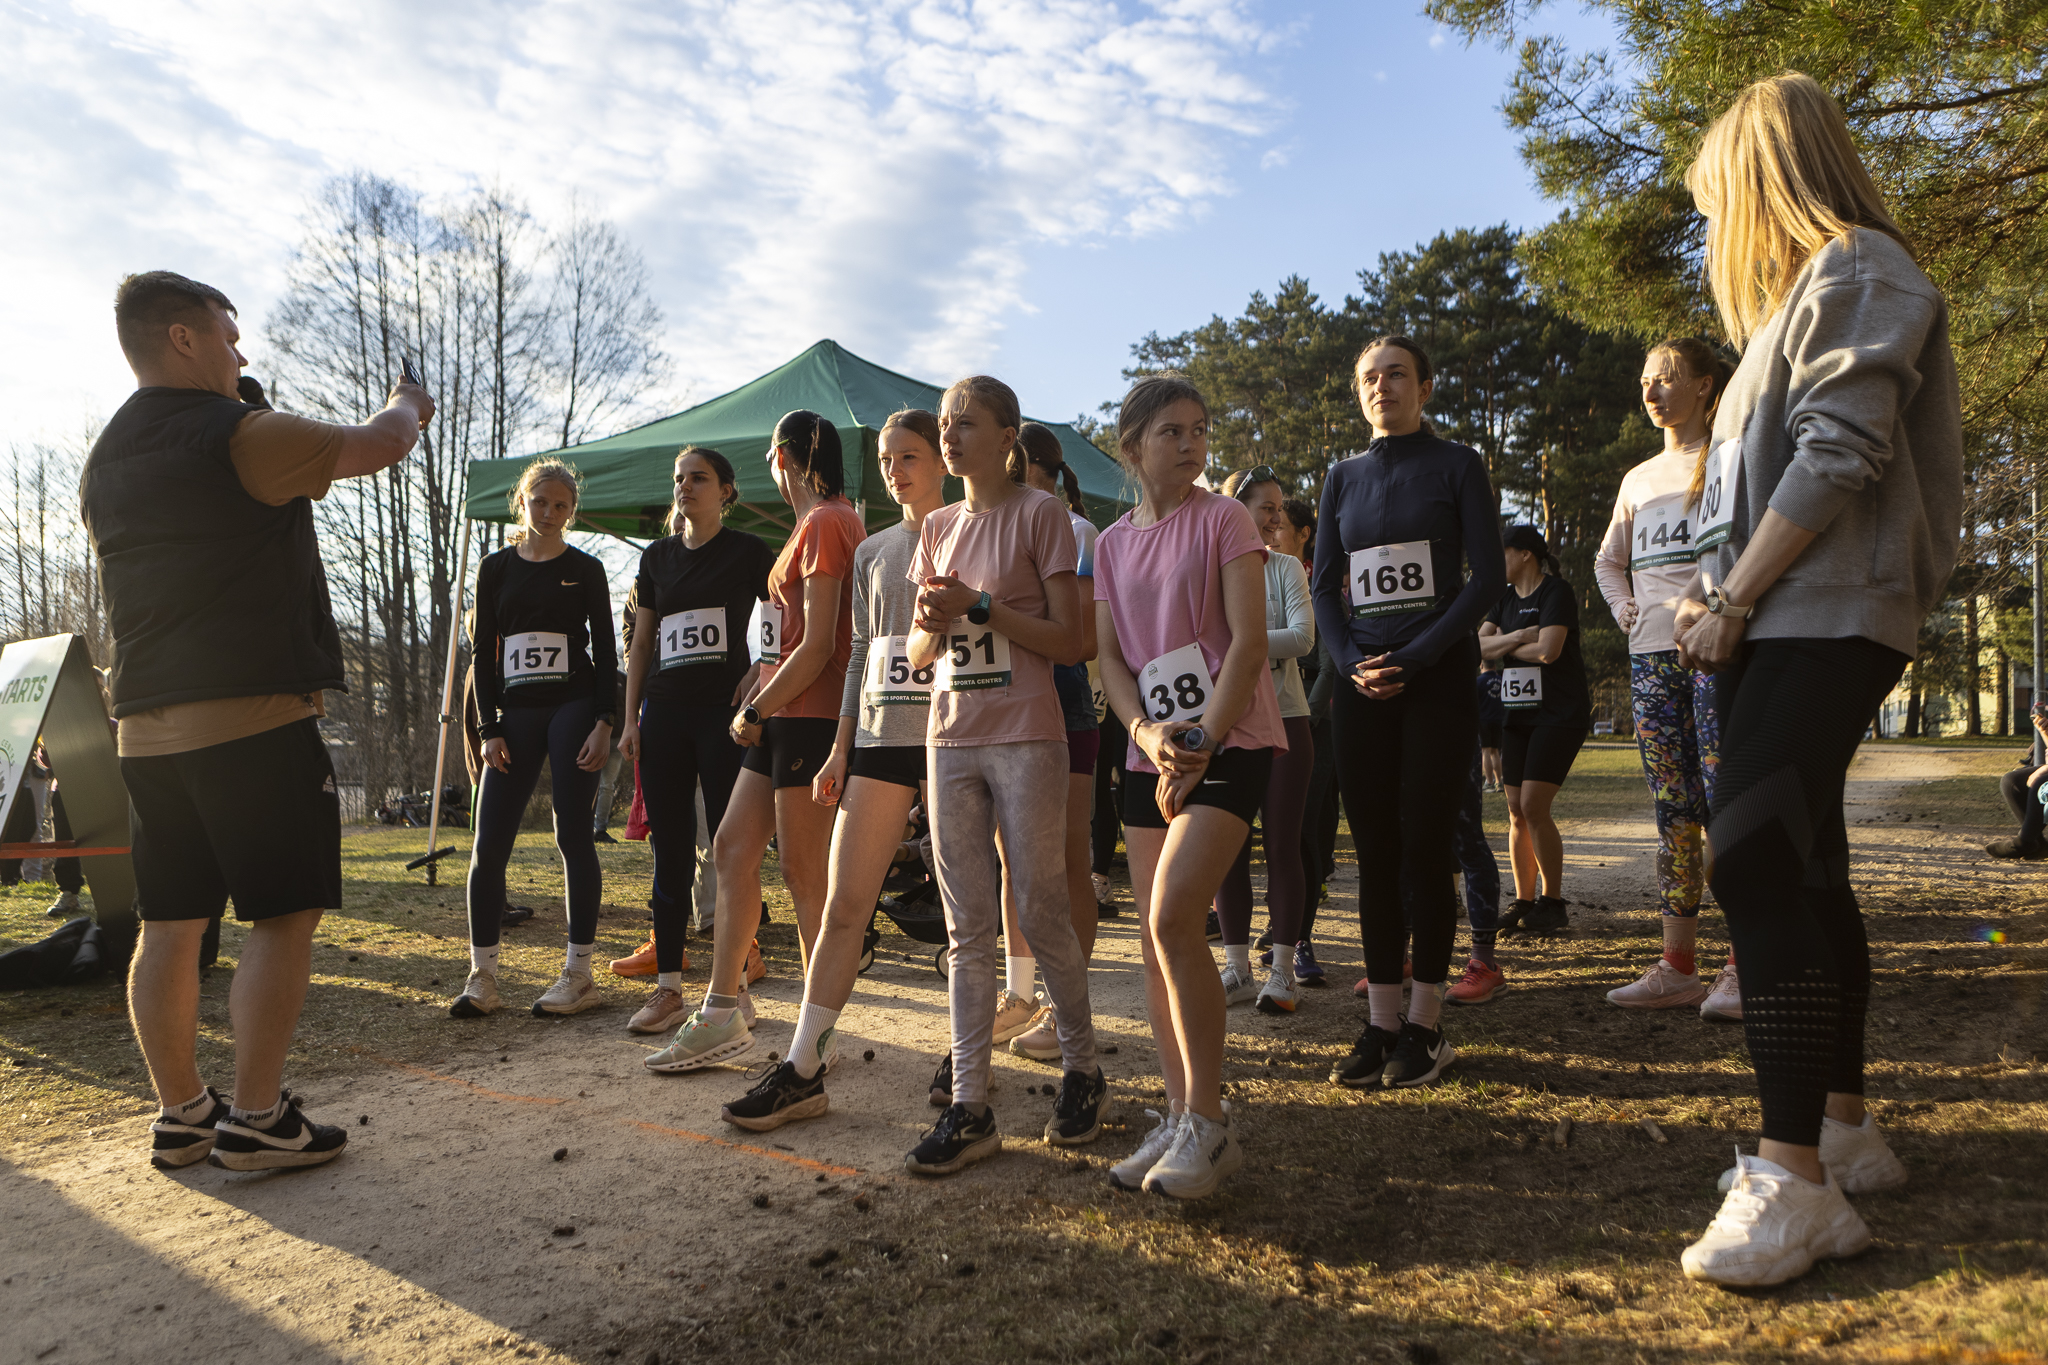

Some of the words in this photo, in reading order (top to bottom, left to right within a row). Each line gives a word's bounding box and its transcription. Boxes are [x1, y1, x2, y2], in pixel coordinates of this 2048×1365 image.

[1702, 475, 1721, 524] 80
[1638, 519, 1691, 552] 144
[1358, 562, 1424, 597] 168
[1380, 604, 1402, 612] SPORTA
[1403, 601, 1427, 609] CENTRS
[667, 624, 720, 652] 150
[761, 621, 775, 647] 3
[510, 647, 561, 670] 157
[873, 656, 934, 684] 158
[0, 674, 48, 704] TARTS
[1503, 679, 1537, 697] 154
[1208, 1136, 1228, 1167] HOKA
